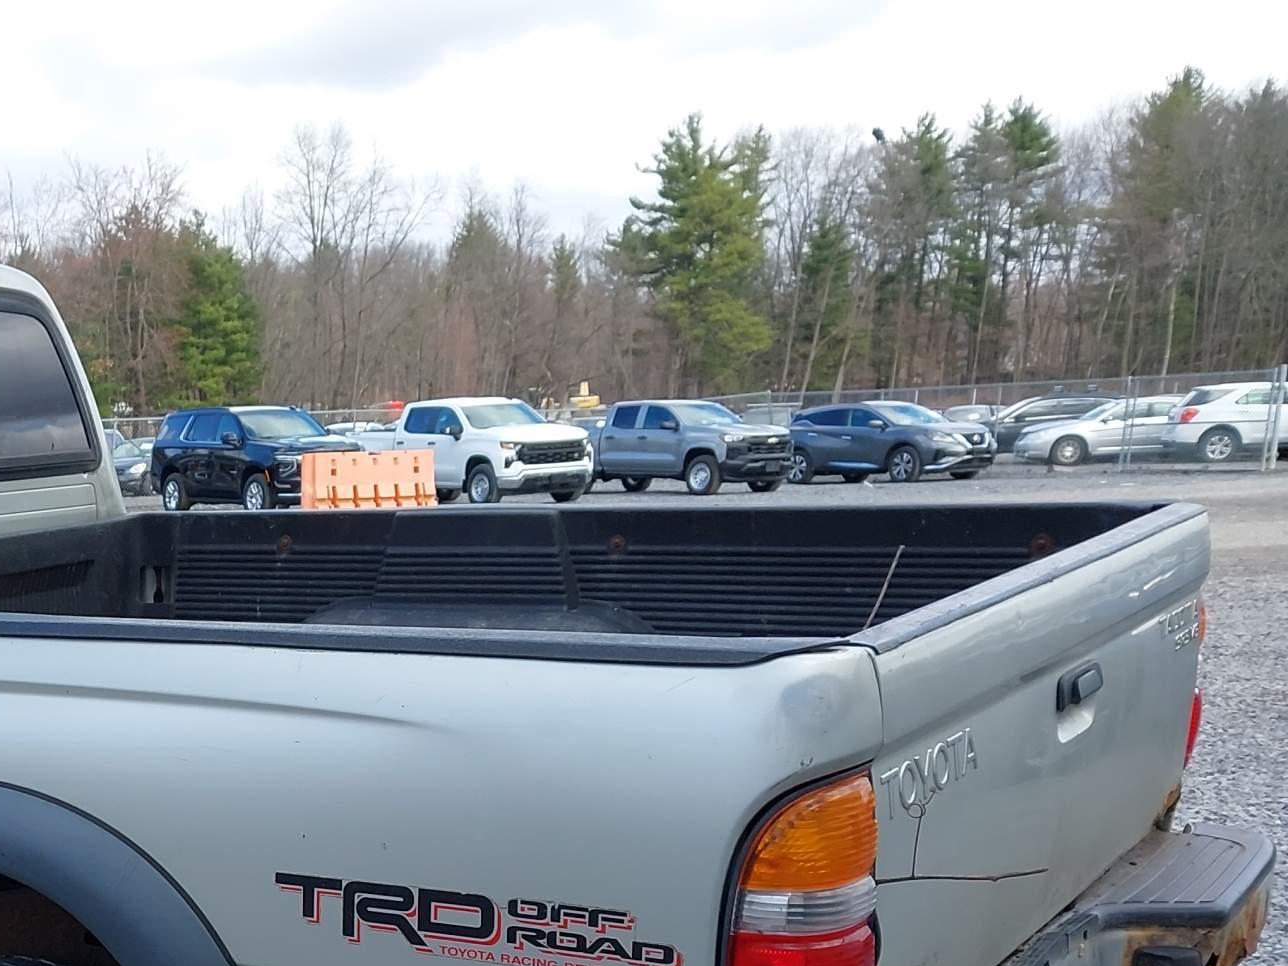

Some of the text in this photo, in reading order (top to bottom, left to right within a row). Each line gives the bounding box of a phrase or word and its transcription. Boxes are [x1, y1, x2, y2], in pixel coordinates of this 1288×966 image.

[880, 727, 978, 820] TOYOTA
[274, 871, 502, 954] TRD
[507, 899, 634, 933] OFF
[439, 944, 496, 963] TOYOTA
